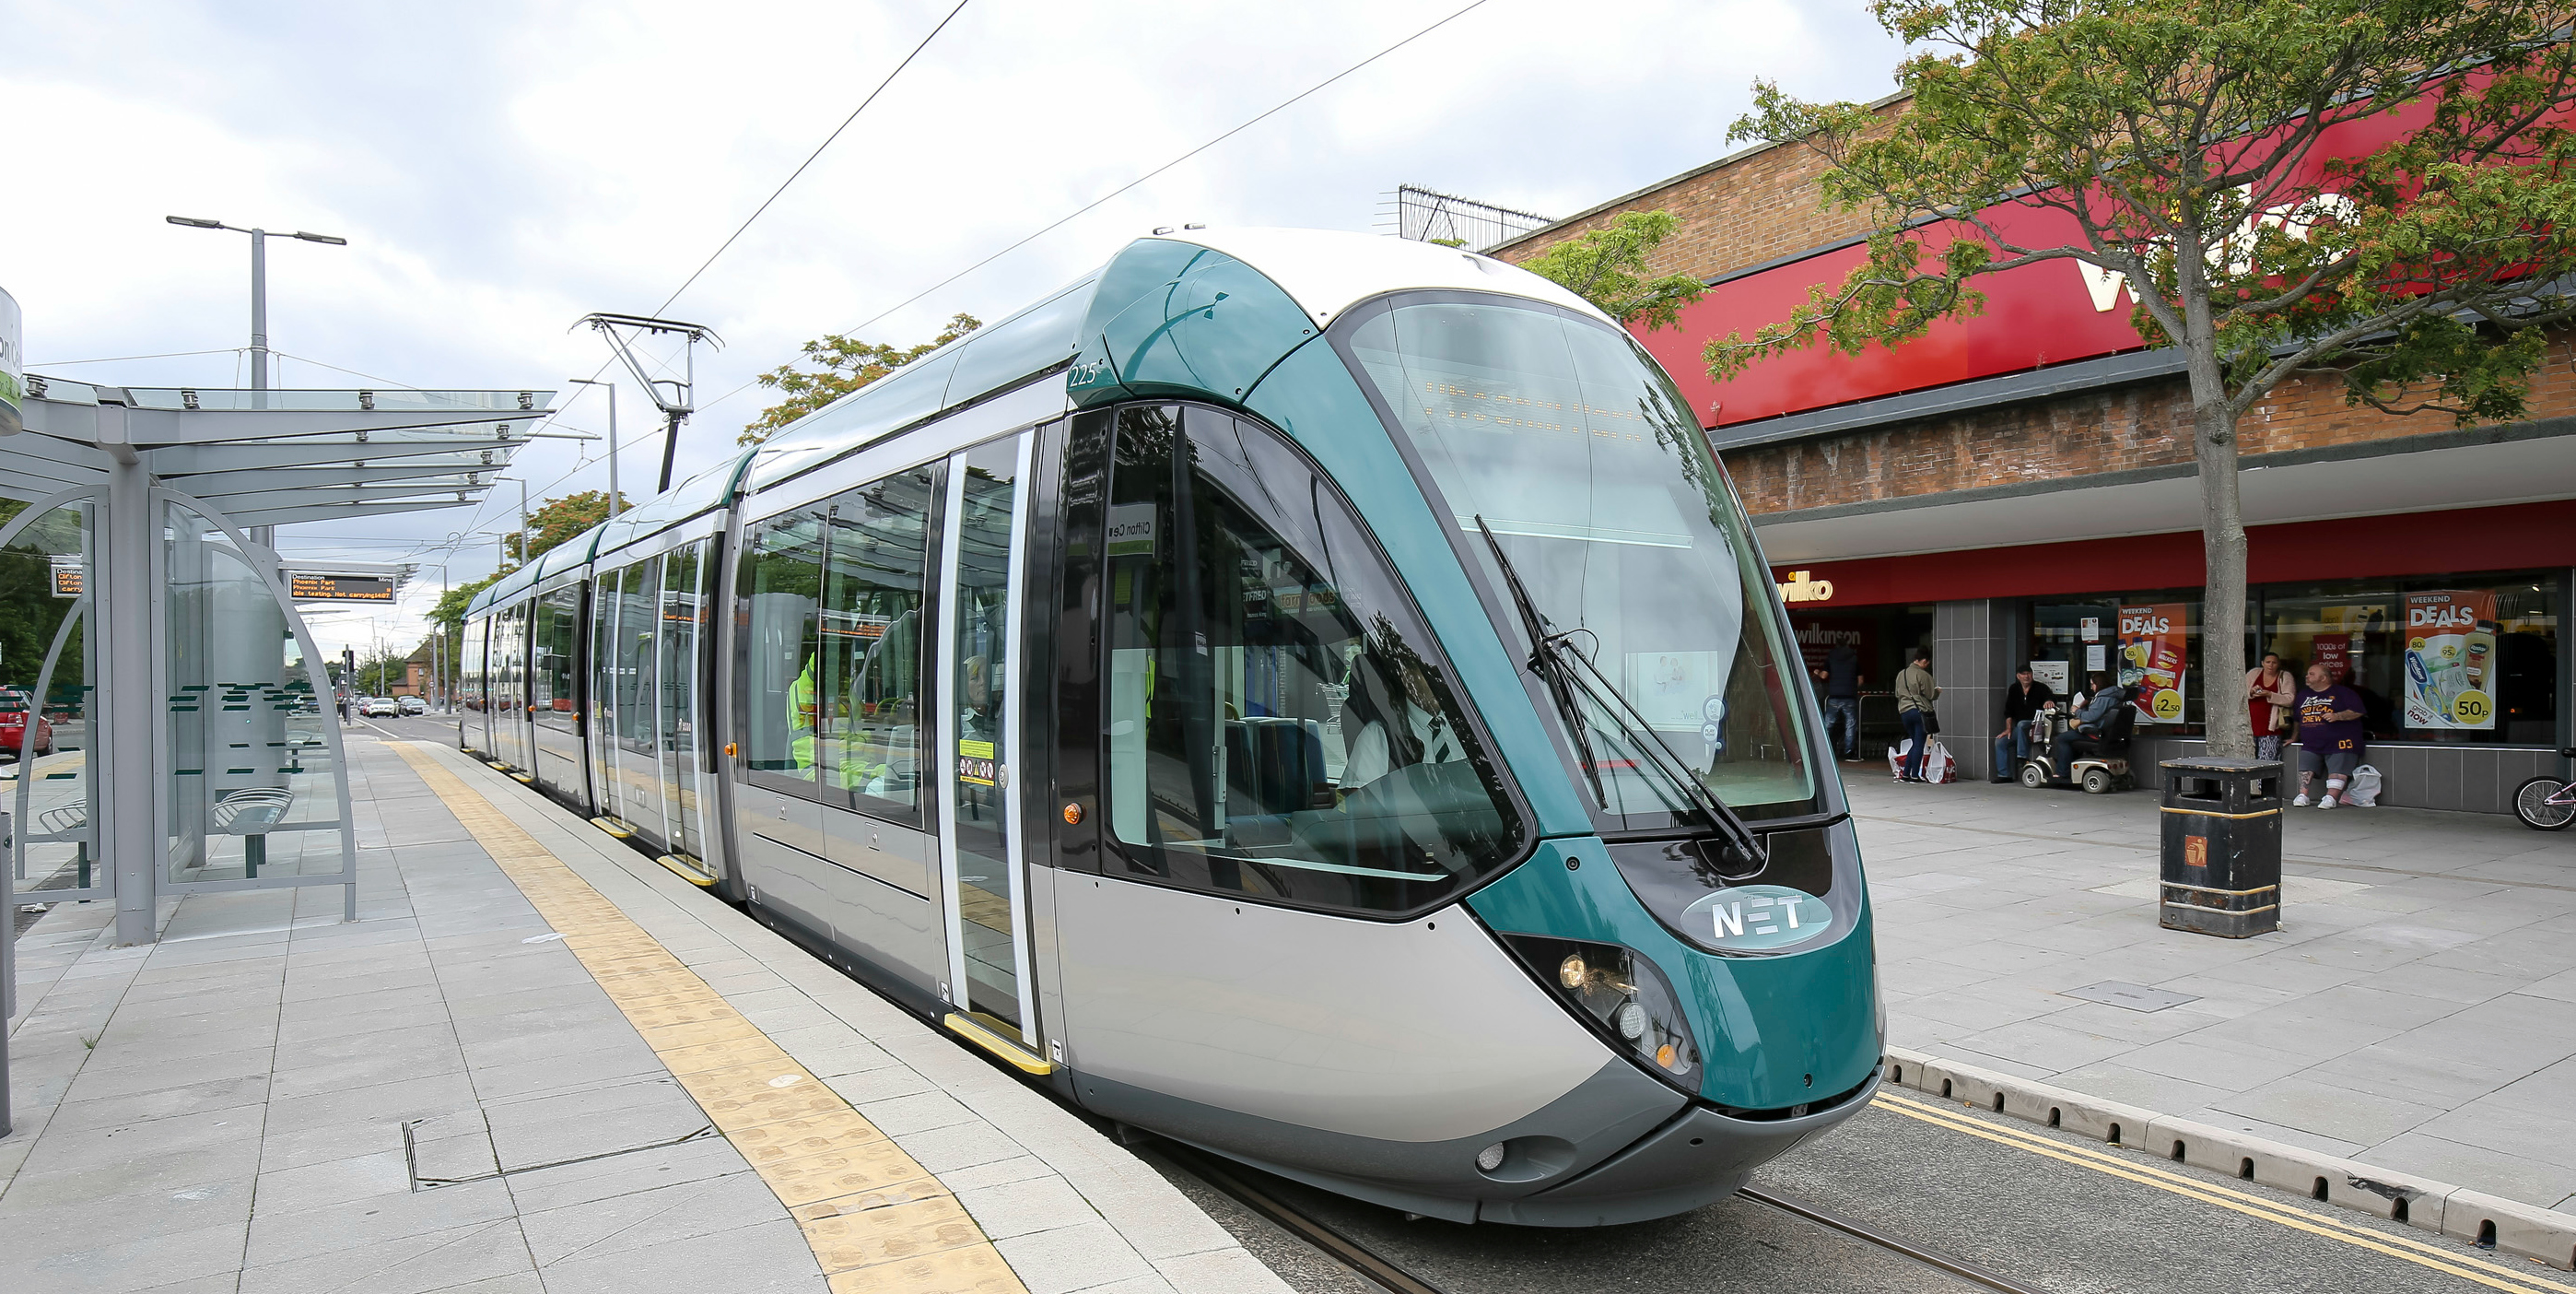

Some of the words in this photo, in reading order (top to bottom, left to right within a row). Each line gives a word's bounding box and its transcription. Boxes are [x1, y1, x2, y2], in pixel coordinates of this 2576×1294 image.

[2076, 182, 2361, 314] wlko
[1070, 362, 1096, 387] 225
[1775, 570, 1833, 603] wilko
[1242, 590, 1267, 602] TFRED
[1281, 589, 1335, 607] faroods
[2409, 595, 2451, 604] WEEKEND
[2122, 616, 2170, 635] DEALS
[2409, 605, 2474, 628] DEALS
[1795, 622, 1861, 645] wilkinson
[2156, 699, 2180, 712] £2.50
[2458, 700, 2489, 718] 50p
[2407, 709, 2429, 725] now
[2338, 738, 2354, 749] 03
[1712, 895, 1803, 938] NET
